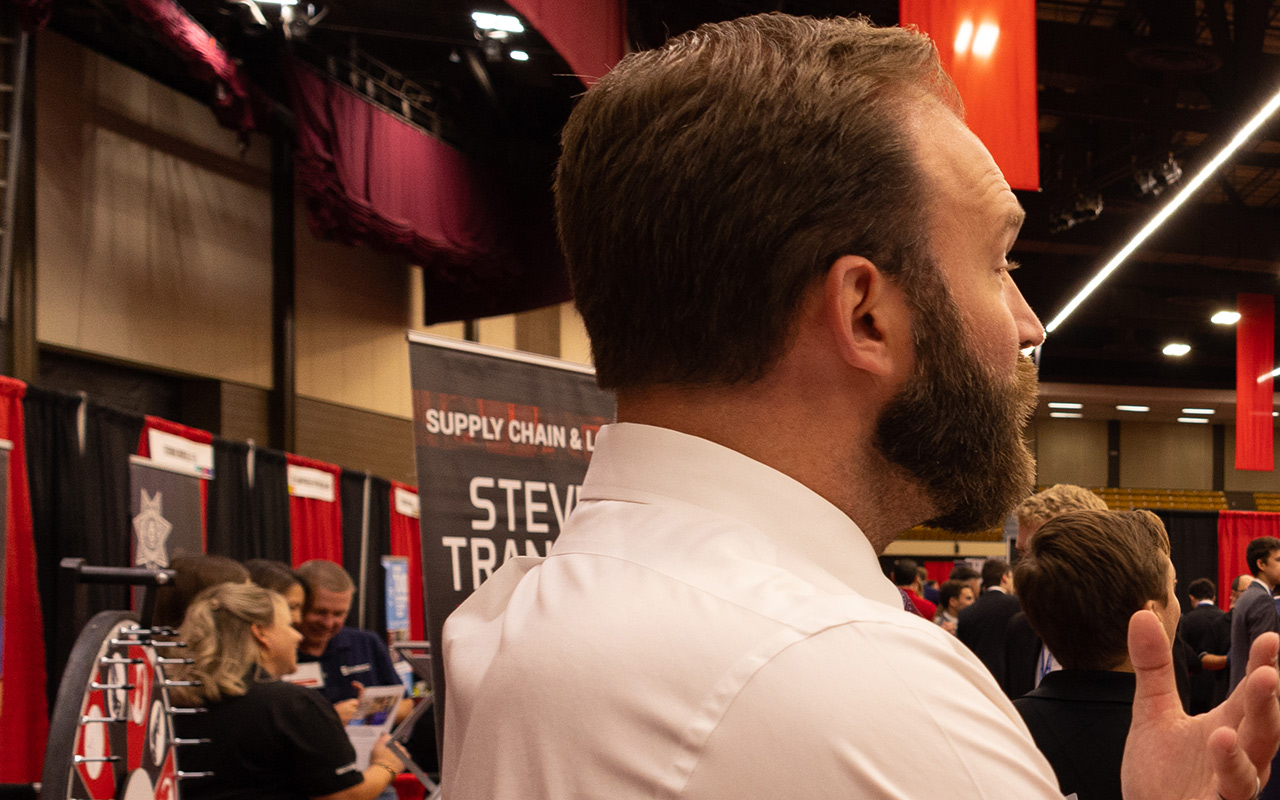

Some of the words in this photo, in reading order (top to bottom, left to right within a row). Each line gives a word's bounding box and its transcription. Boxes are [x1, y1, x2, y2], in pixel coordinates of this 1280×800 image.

[426, 408, 504, 441] SUPPLY
[508, 419, 566, 449] CHAIN
[570, 427, 583, 450] &
